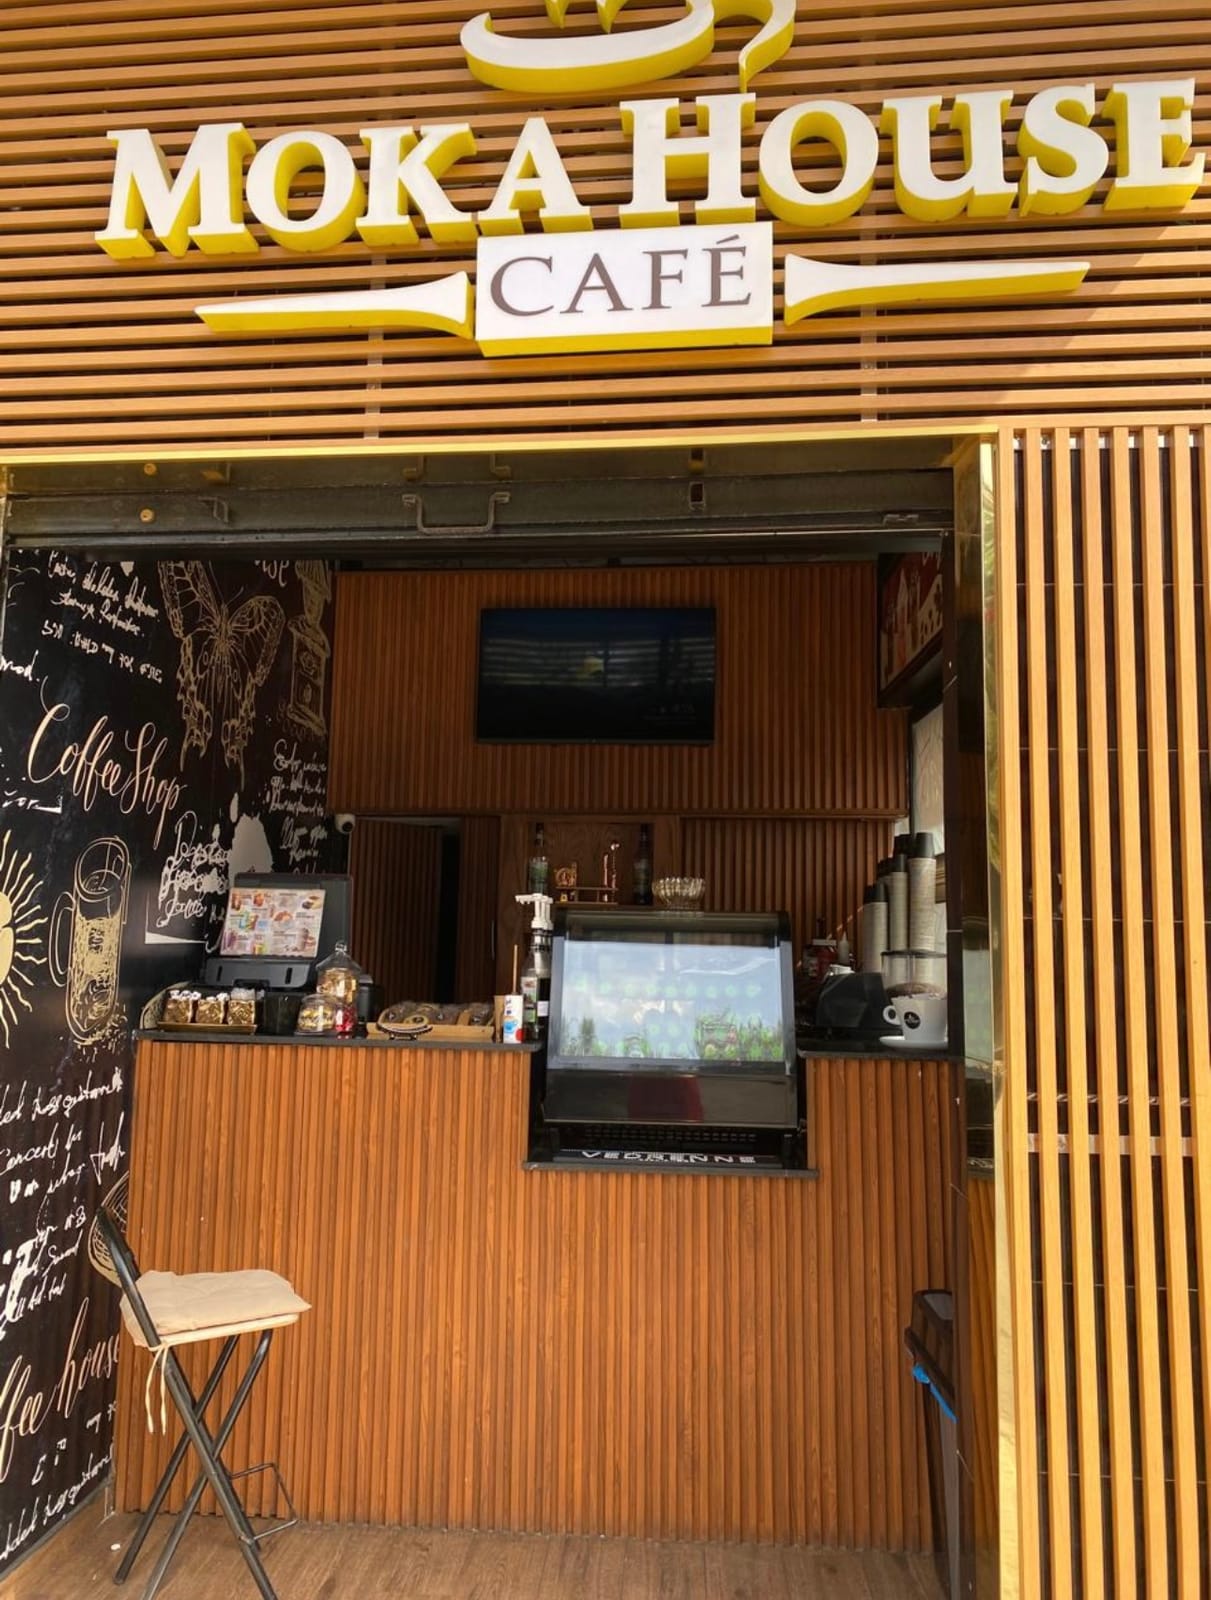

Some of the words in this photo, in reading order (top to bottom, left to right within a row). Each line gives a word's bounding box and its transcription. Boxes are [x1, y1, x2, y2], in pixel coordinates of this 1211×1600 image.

[95, 117, 593, 256] MOKA
[620, 78, 1205, 226] HOUSE
[489, 233, 753, 317] CAFÉ
[28, 680, 124, 812] Coffee
[120, 721, 188, 850] Shop
